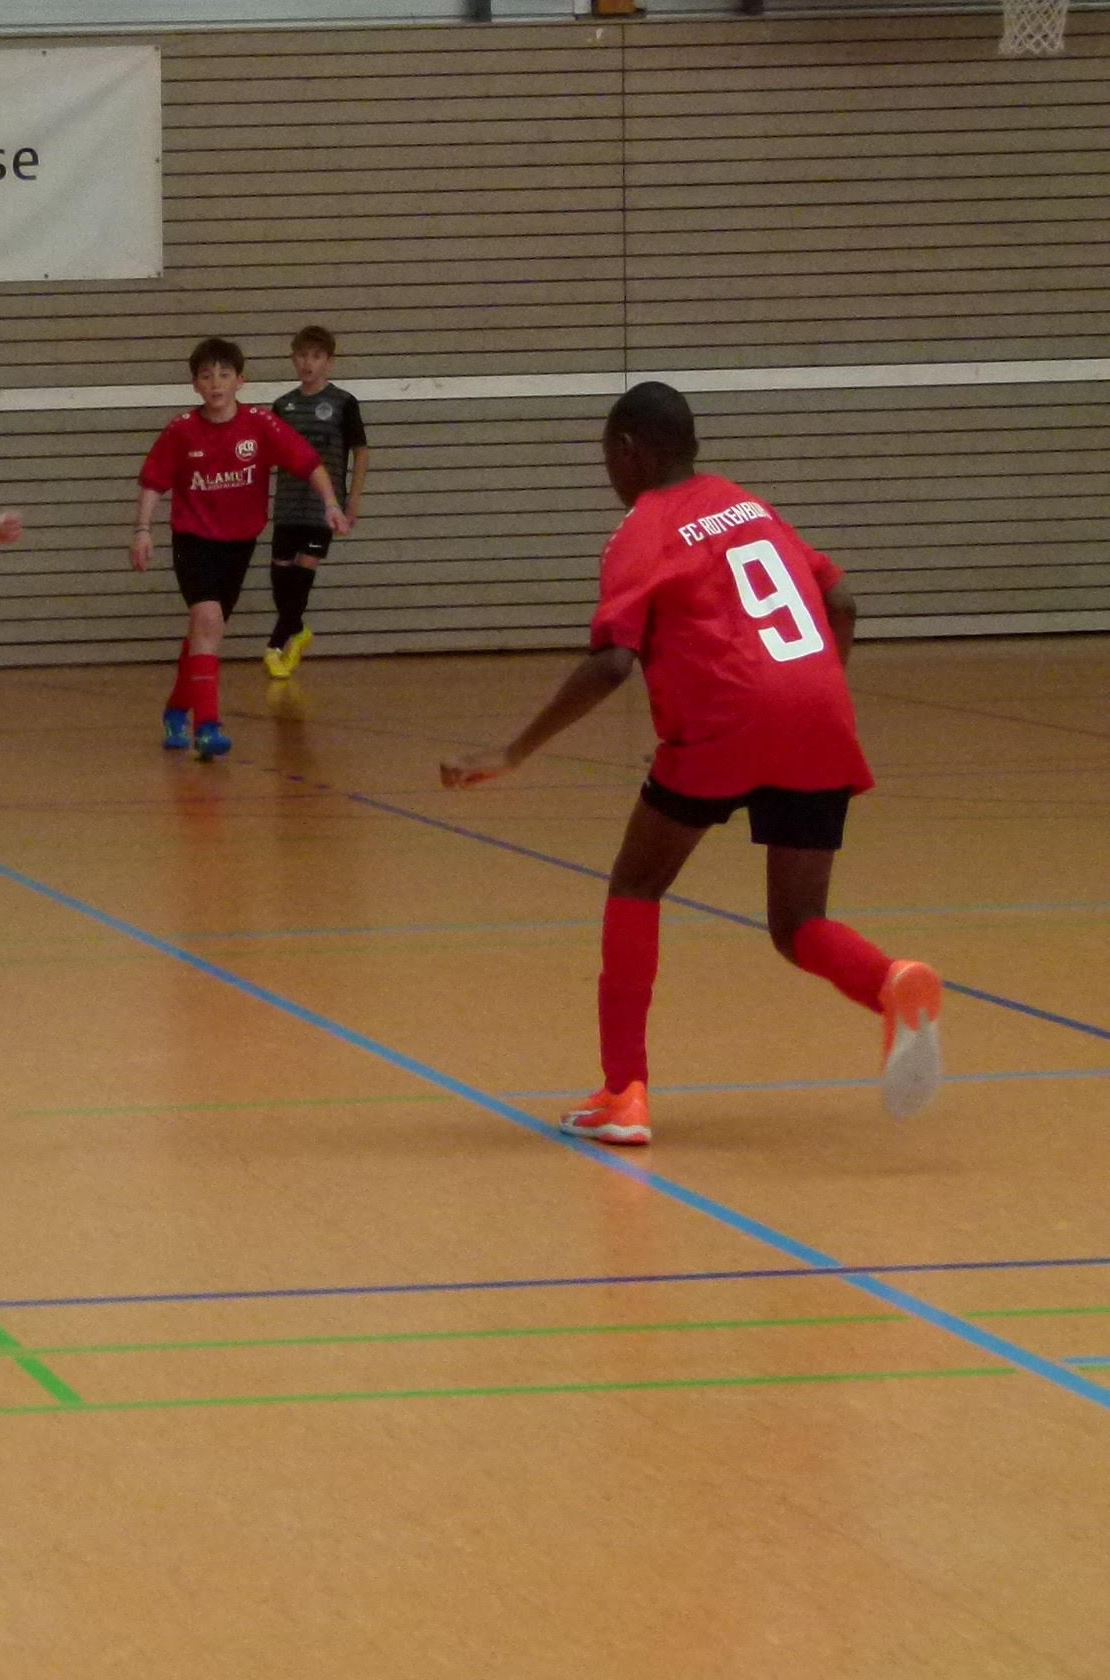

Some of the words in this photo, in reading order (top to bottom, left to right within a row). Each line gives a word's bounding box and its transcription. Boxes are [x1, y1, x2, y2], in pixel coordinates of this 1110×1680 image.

[678, 523, 705, 546] FC
[697, 501, 773, 536] ROTTENBU
[726, 539, 824, 662] 9
